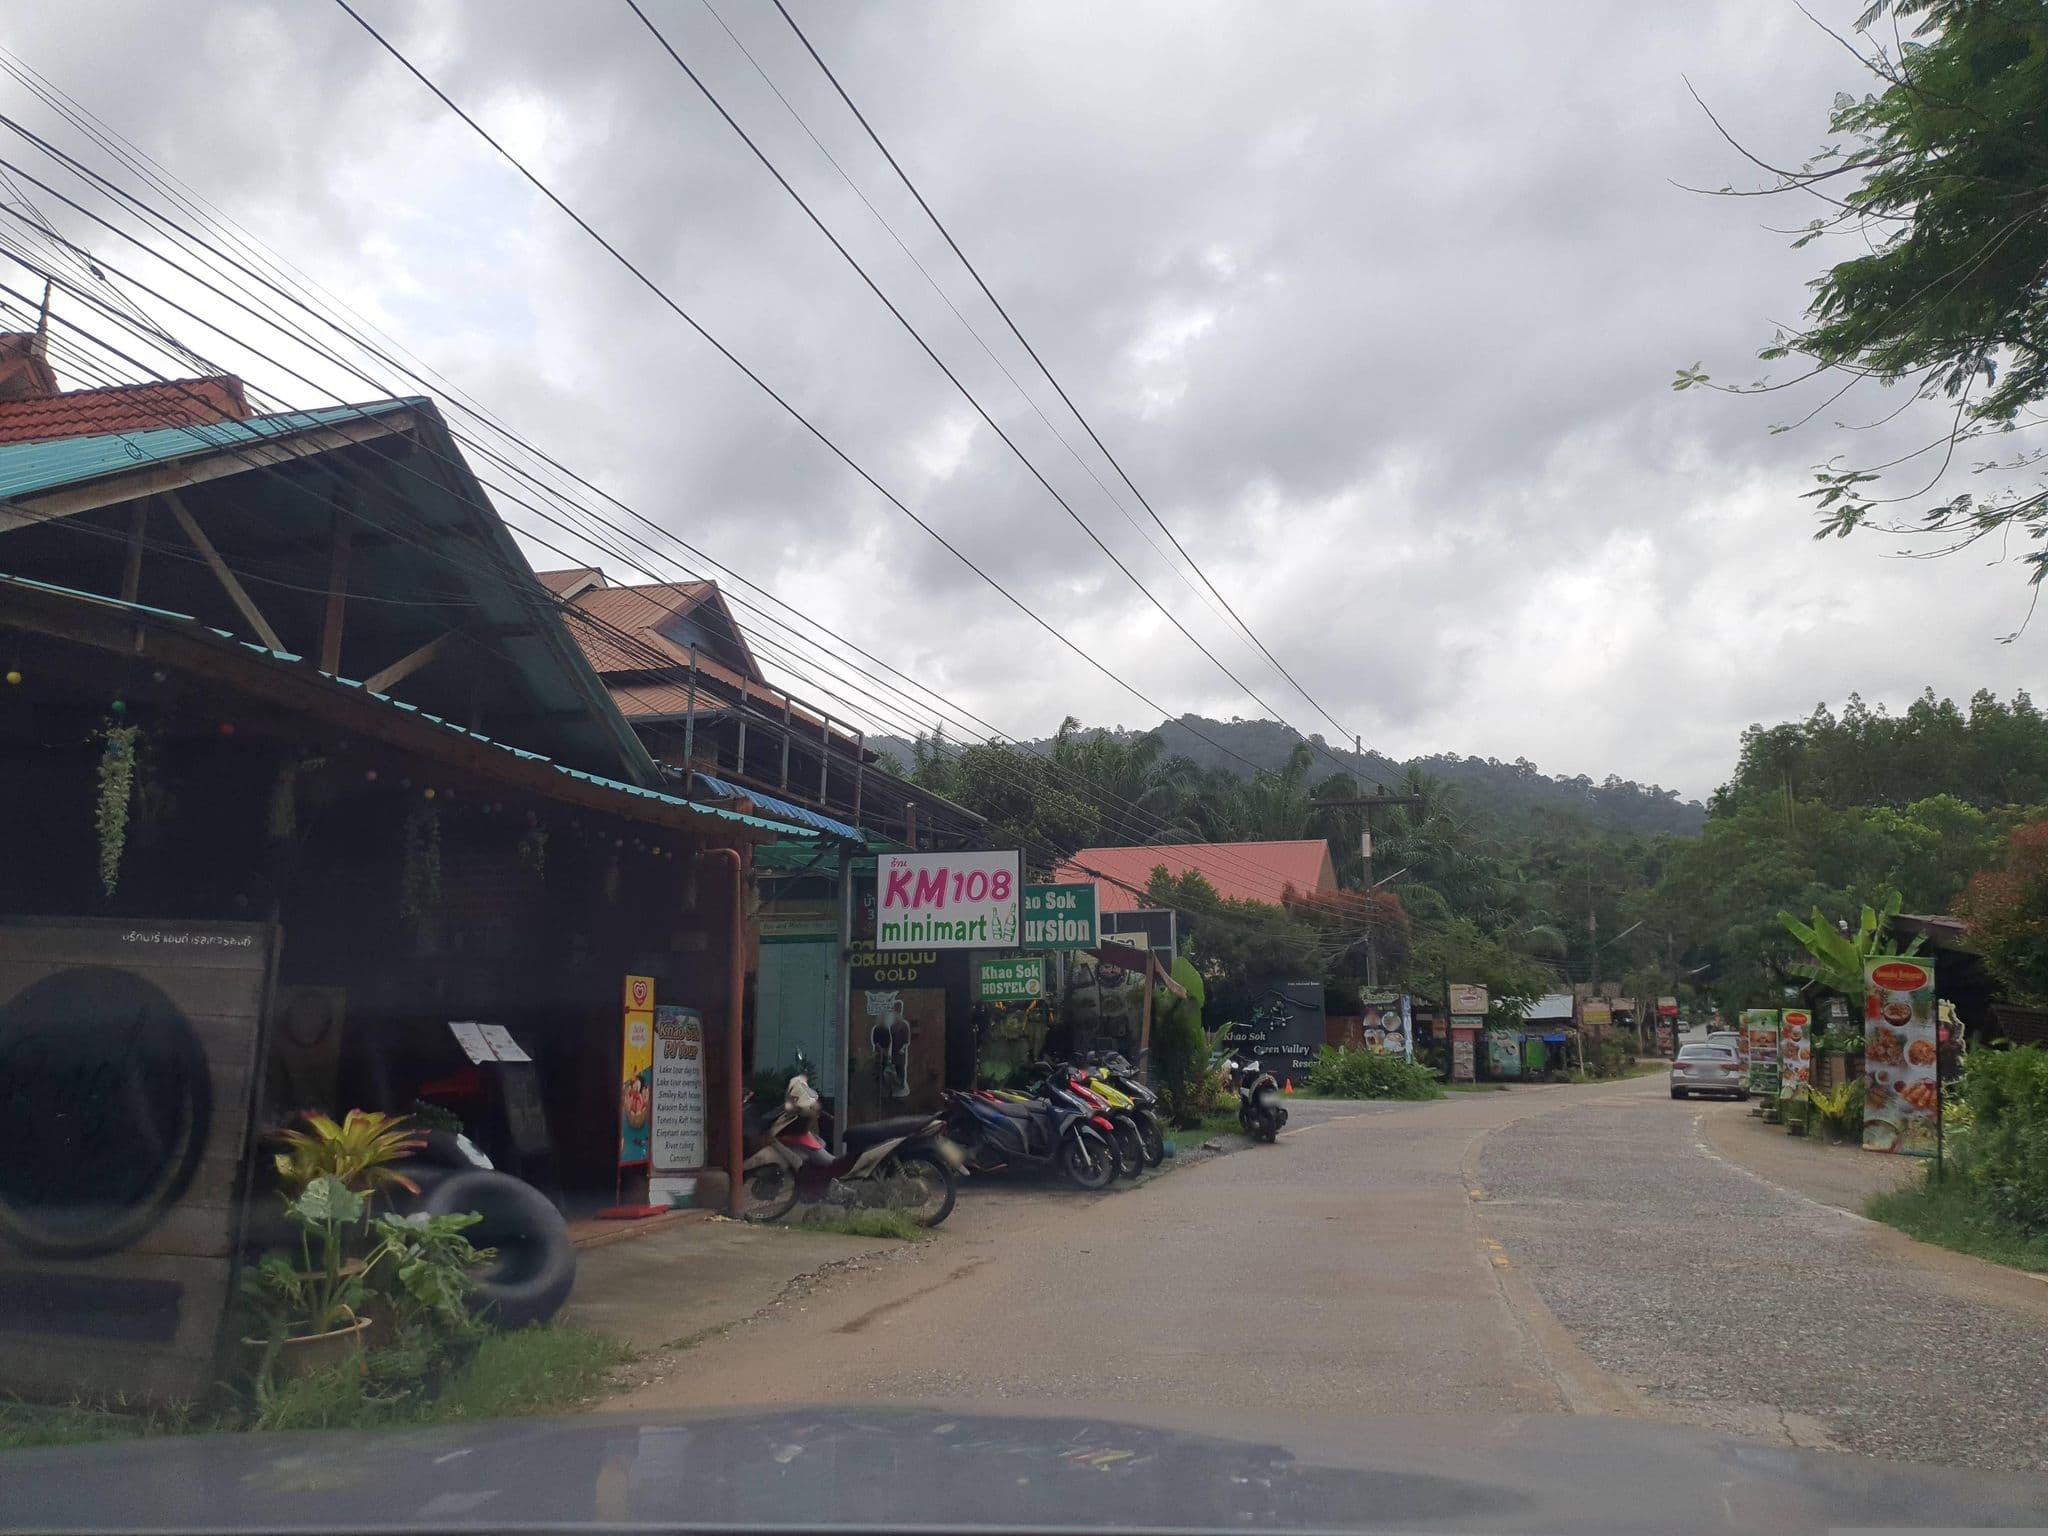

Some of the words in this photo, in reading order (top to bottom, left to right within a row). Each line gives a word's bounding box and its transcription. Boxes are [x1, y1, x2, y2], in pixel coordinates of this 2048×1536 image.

[884, 868, 949, 910] KM
[952, 869, 1014, 902] 108
[1046, 891, 1077, 909] Sok
[881, 912, 987, 943] minimart
[874, 968, 917, 982] GOLD
[981, 966, 1013, 979] Khao
[1015, 965, 1040, 978] Sok
[981, 981, 1026, 994] HOSTEL
[1249, 1032, 1266, 1040] Sok
[1281, 1044, 1310, 1056] Valley
